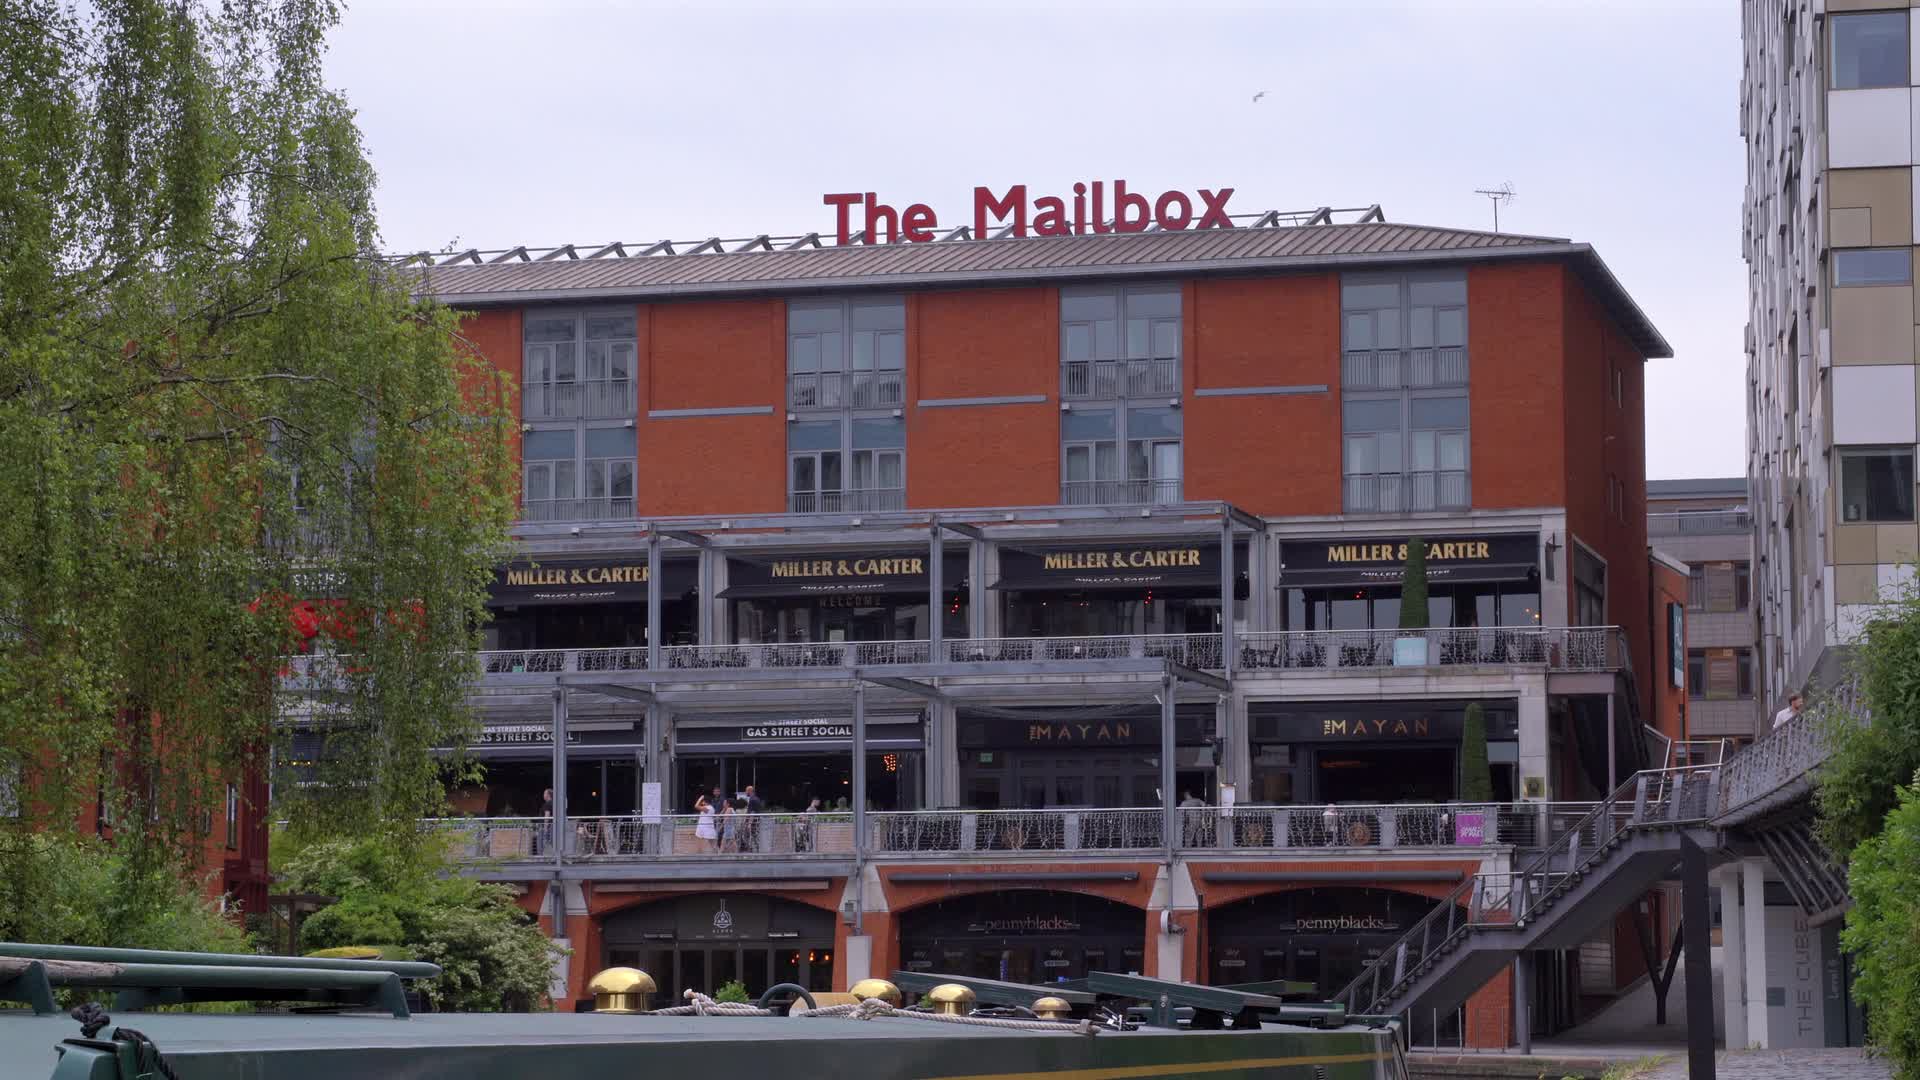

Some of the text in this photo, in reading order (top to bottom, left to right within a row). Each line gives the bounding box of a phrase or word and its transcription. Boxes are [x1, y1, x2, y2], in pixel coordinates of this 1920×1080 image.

[823, 180, 1235, 246] The Mailbox
[1045, 549, 1200, 569] MILLER & CARTER
[1327, 544, 1393, 562] MILLER
[1424, 542, 1490, 560] ARTER
[772, 557, 923, 577] MILLER & CARTER
[506, 568, 567, 586] MILLER
[570, 568, 585, 584] &
[522, 724, 546, 732] SOCIAL
[746, 726, 852, 737] GAS STREET SOCIAL
[1037, 723, 1130, 740] MAYAN
[1331, 718, 1428, 735] MAYAN
[495, 732, 533, 742] STREET
[985, 915, 1070, 934] pennyblacks
[1296, 915, 1385, 933] pennyblacks
[1793, 919, 1814, 1037] THE CUBE
